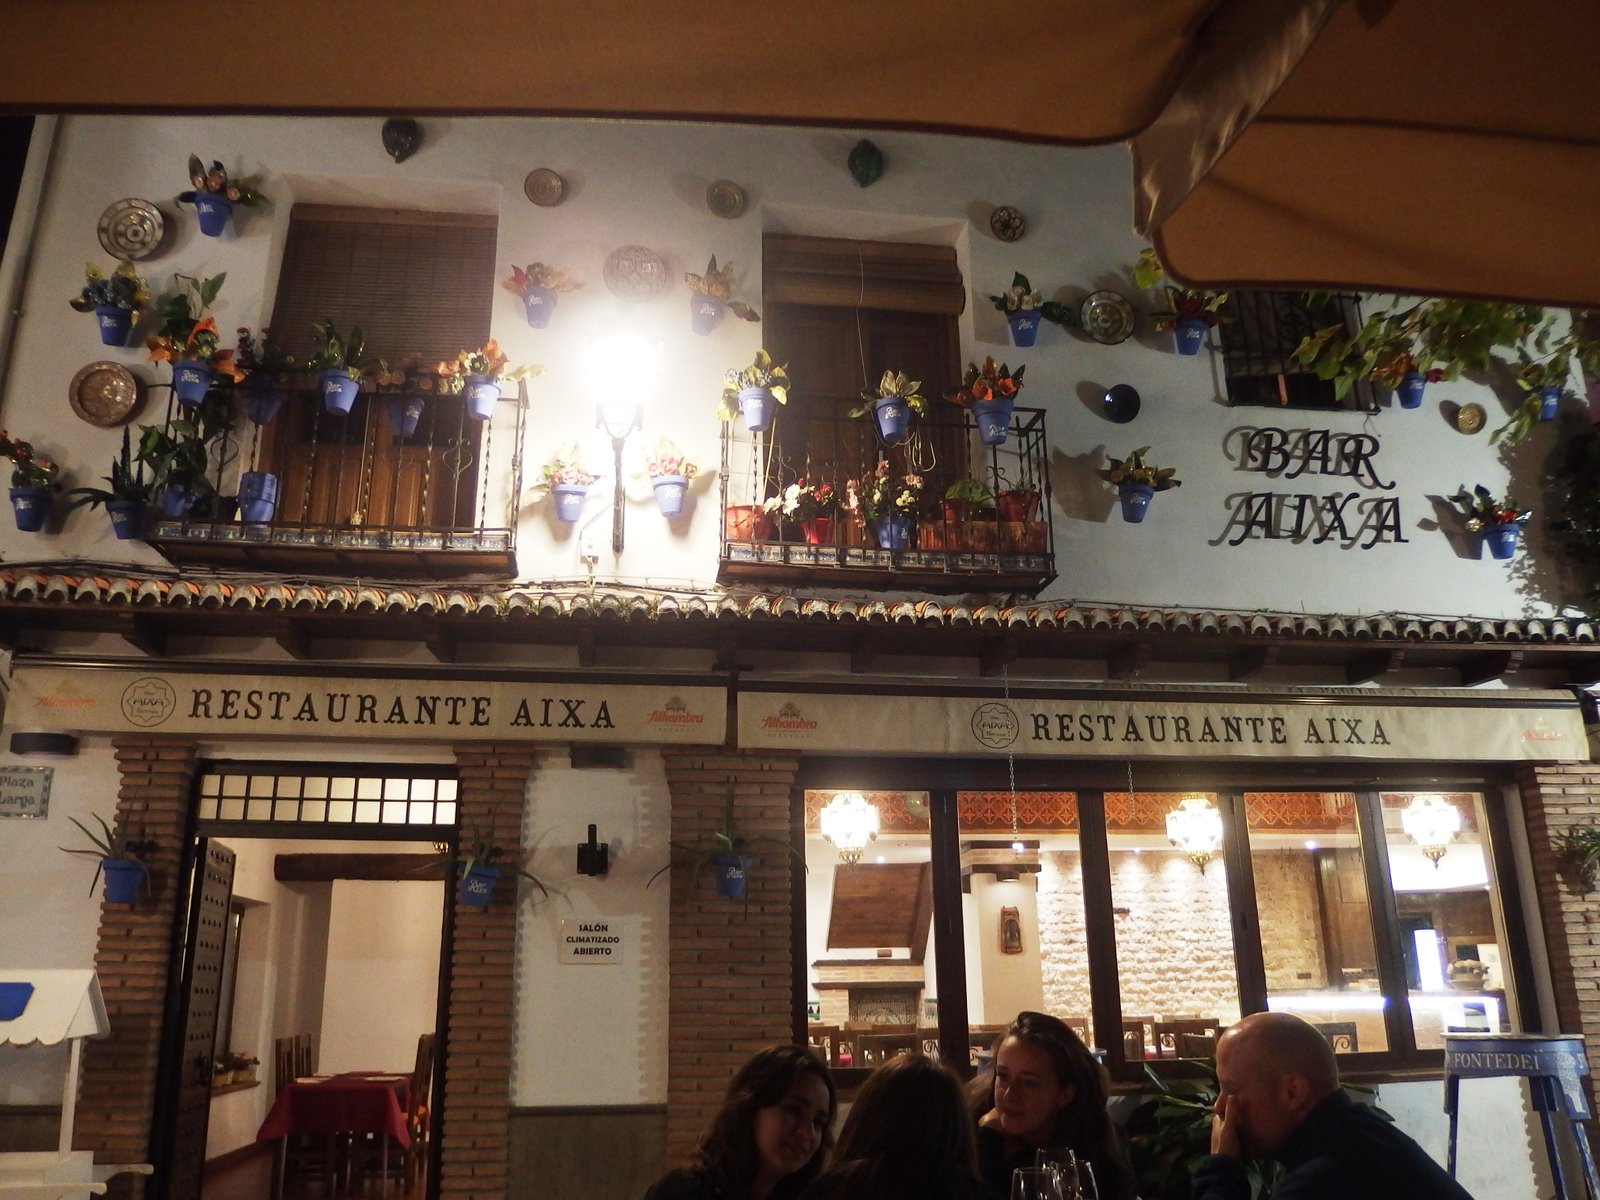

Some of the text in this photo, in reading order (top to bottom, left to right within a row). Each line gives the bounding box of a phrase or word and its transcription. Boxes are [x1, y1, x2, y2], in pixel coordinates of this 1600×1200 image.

[1246, 426, 1396, 490] BAR
[1228, 491, 1409, 550] AIXA
[188, 688, 616, 729] RESTAURANTE AIXA
[647, 709, 704, 725] Alhambra
[761, 715, 818, 731] Alhambra
[1031, 712, 1392, 746] RESTAURANTE AIXA
[0, 776, 34, 788] Plaza
[578, 922, 608, 932] SALÓN
[573, 947, 612, 955] ABIERTO
